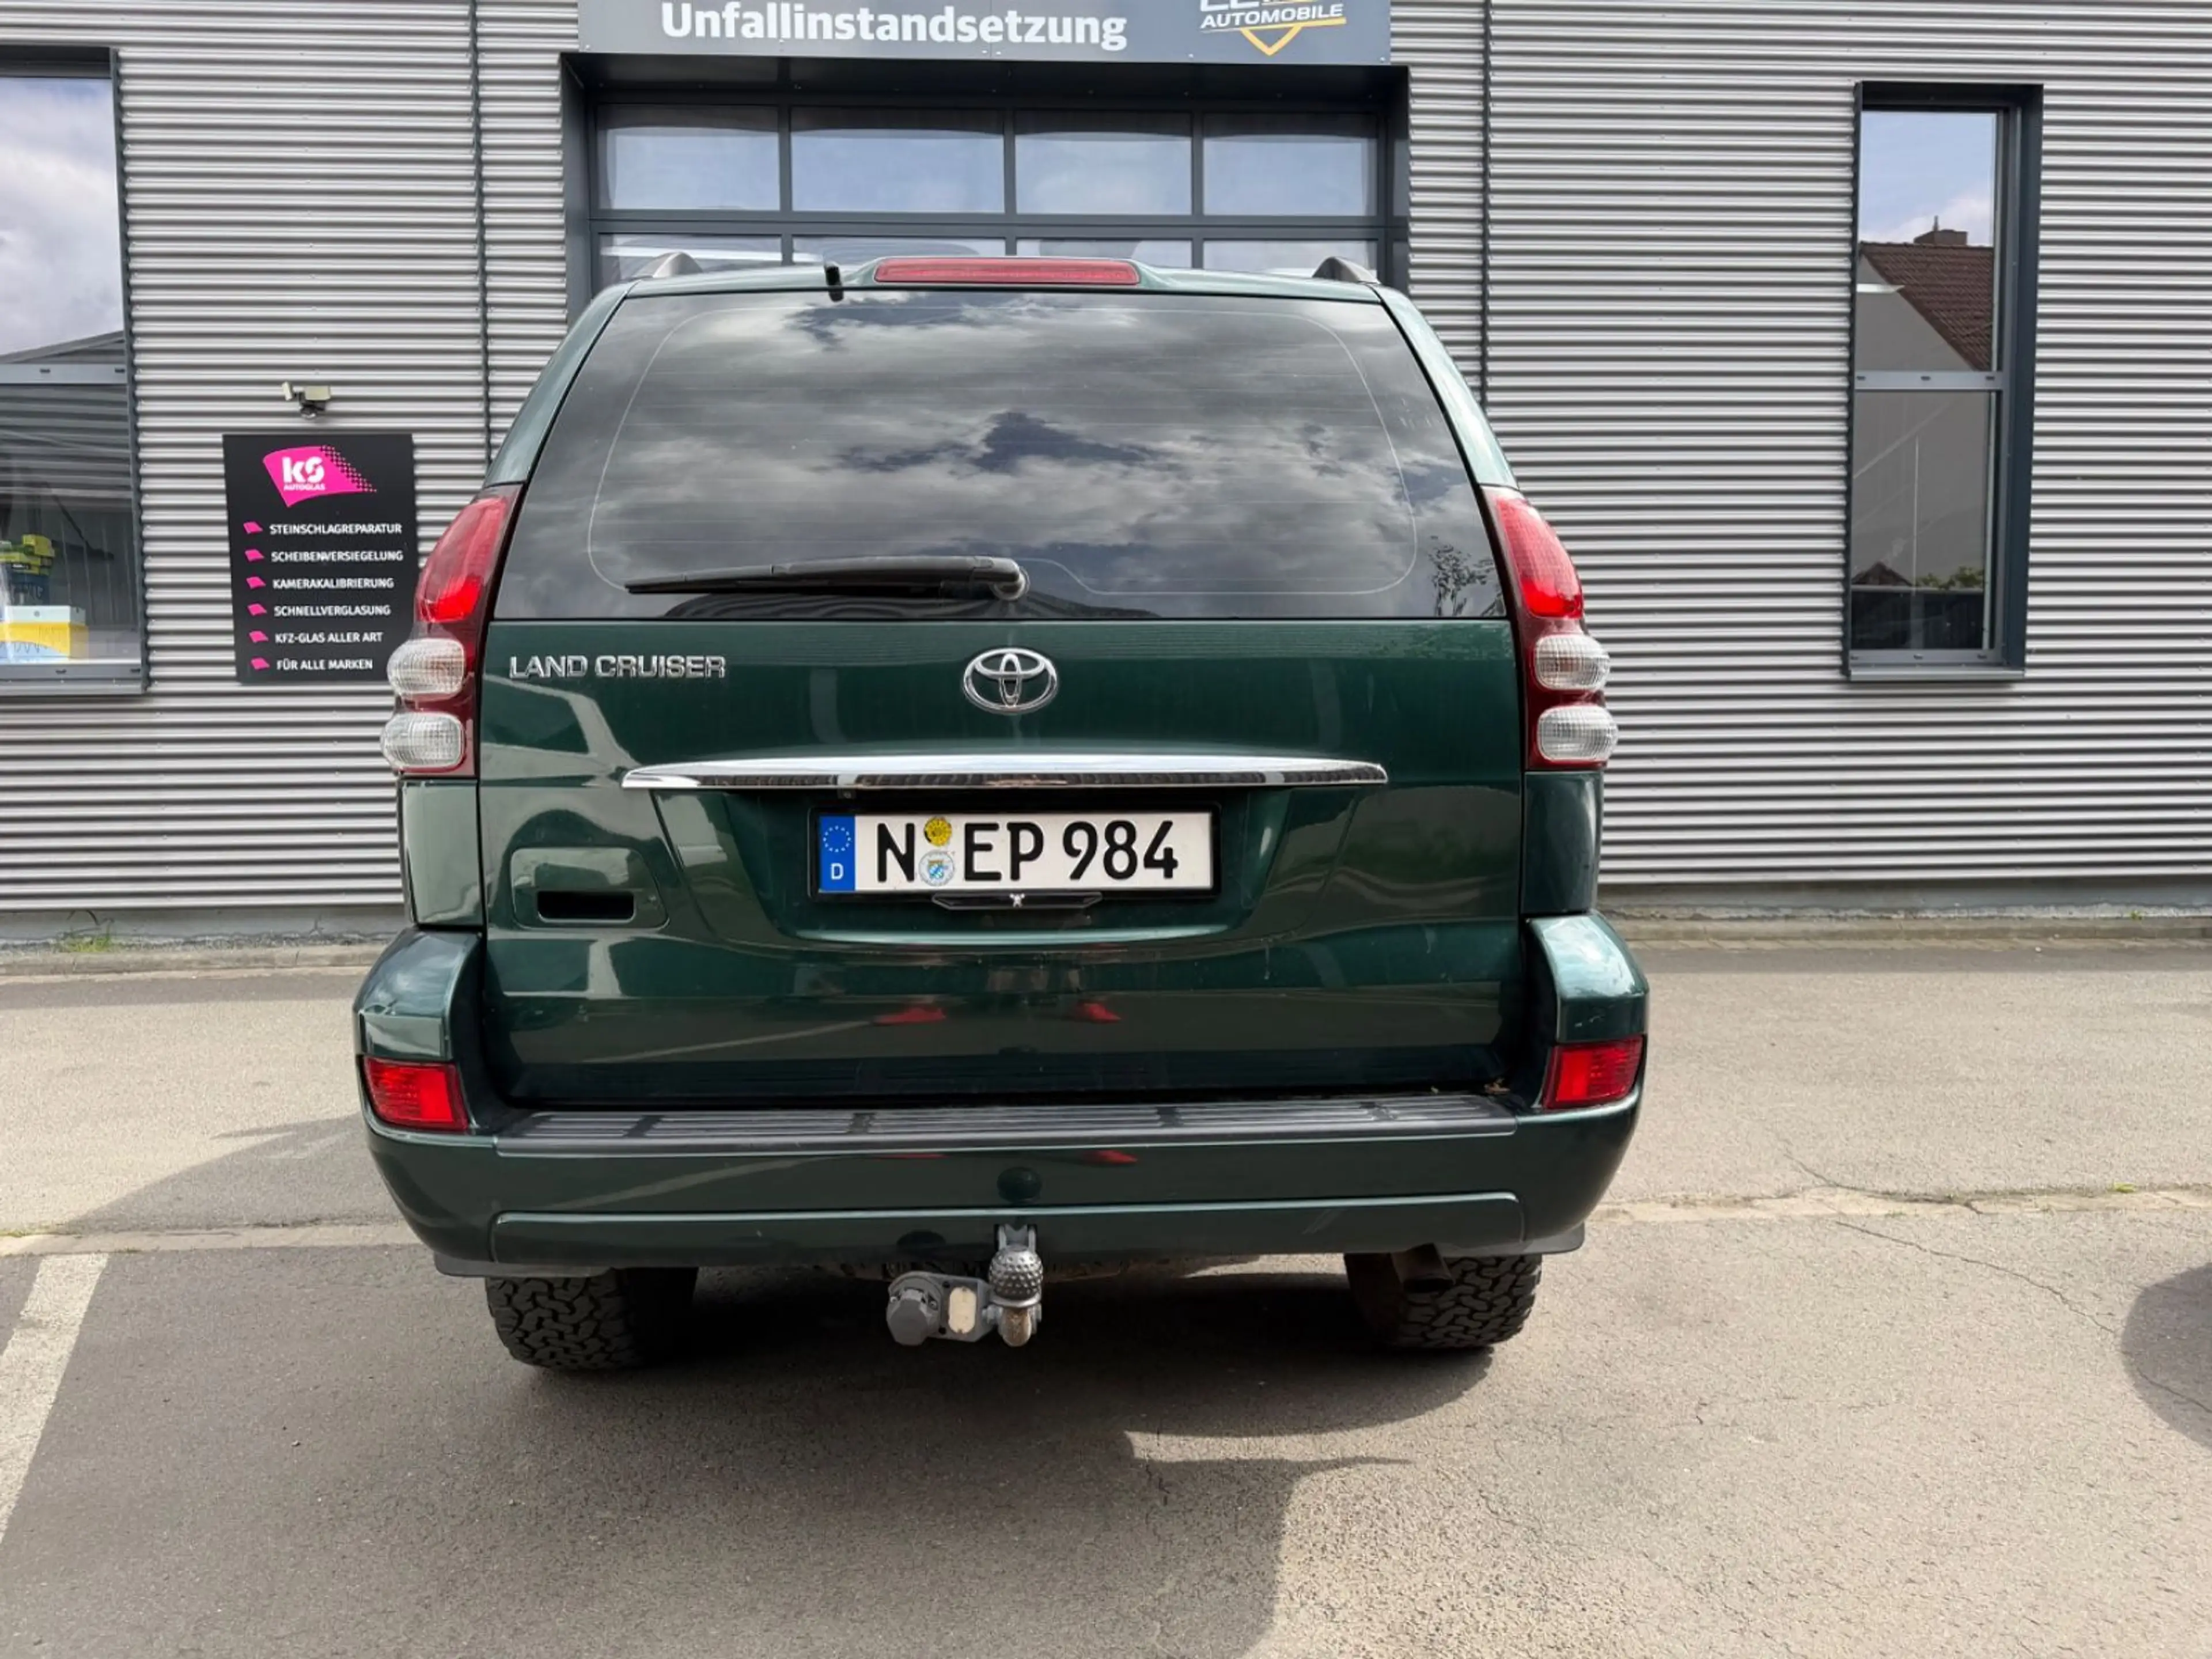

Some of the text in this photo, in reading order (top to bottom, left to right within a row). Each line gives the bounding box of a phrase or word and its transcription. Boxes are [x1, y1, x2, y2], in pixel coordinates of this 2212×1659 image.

[1200, 3, 1343, 28] AUTOMOBILE
[661, 1, 1127, 51] Unfallinstandsetzung
[270, 523, 403, 535] STEINSCHLAGREPARATUR
[271, 551, 404, 562] SCHEIBENVERSIEGELUNG
[272, 577, 395, 589] KAMERAKALIBRIERUNG
[274, 604, 392, 616] SCHNELLVERGLASUNG
[275, 631, 384, 643] KFZ-GLAS ALLER ART
[276, 658, 373, 670] FÜR ALLE MARKEN
[509, 655, 726, 679] LAND CRUISER
[877, 820, 1179, 882] N EP 984
[831, 862, 844, 880] D
